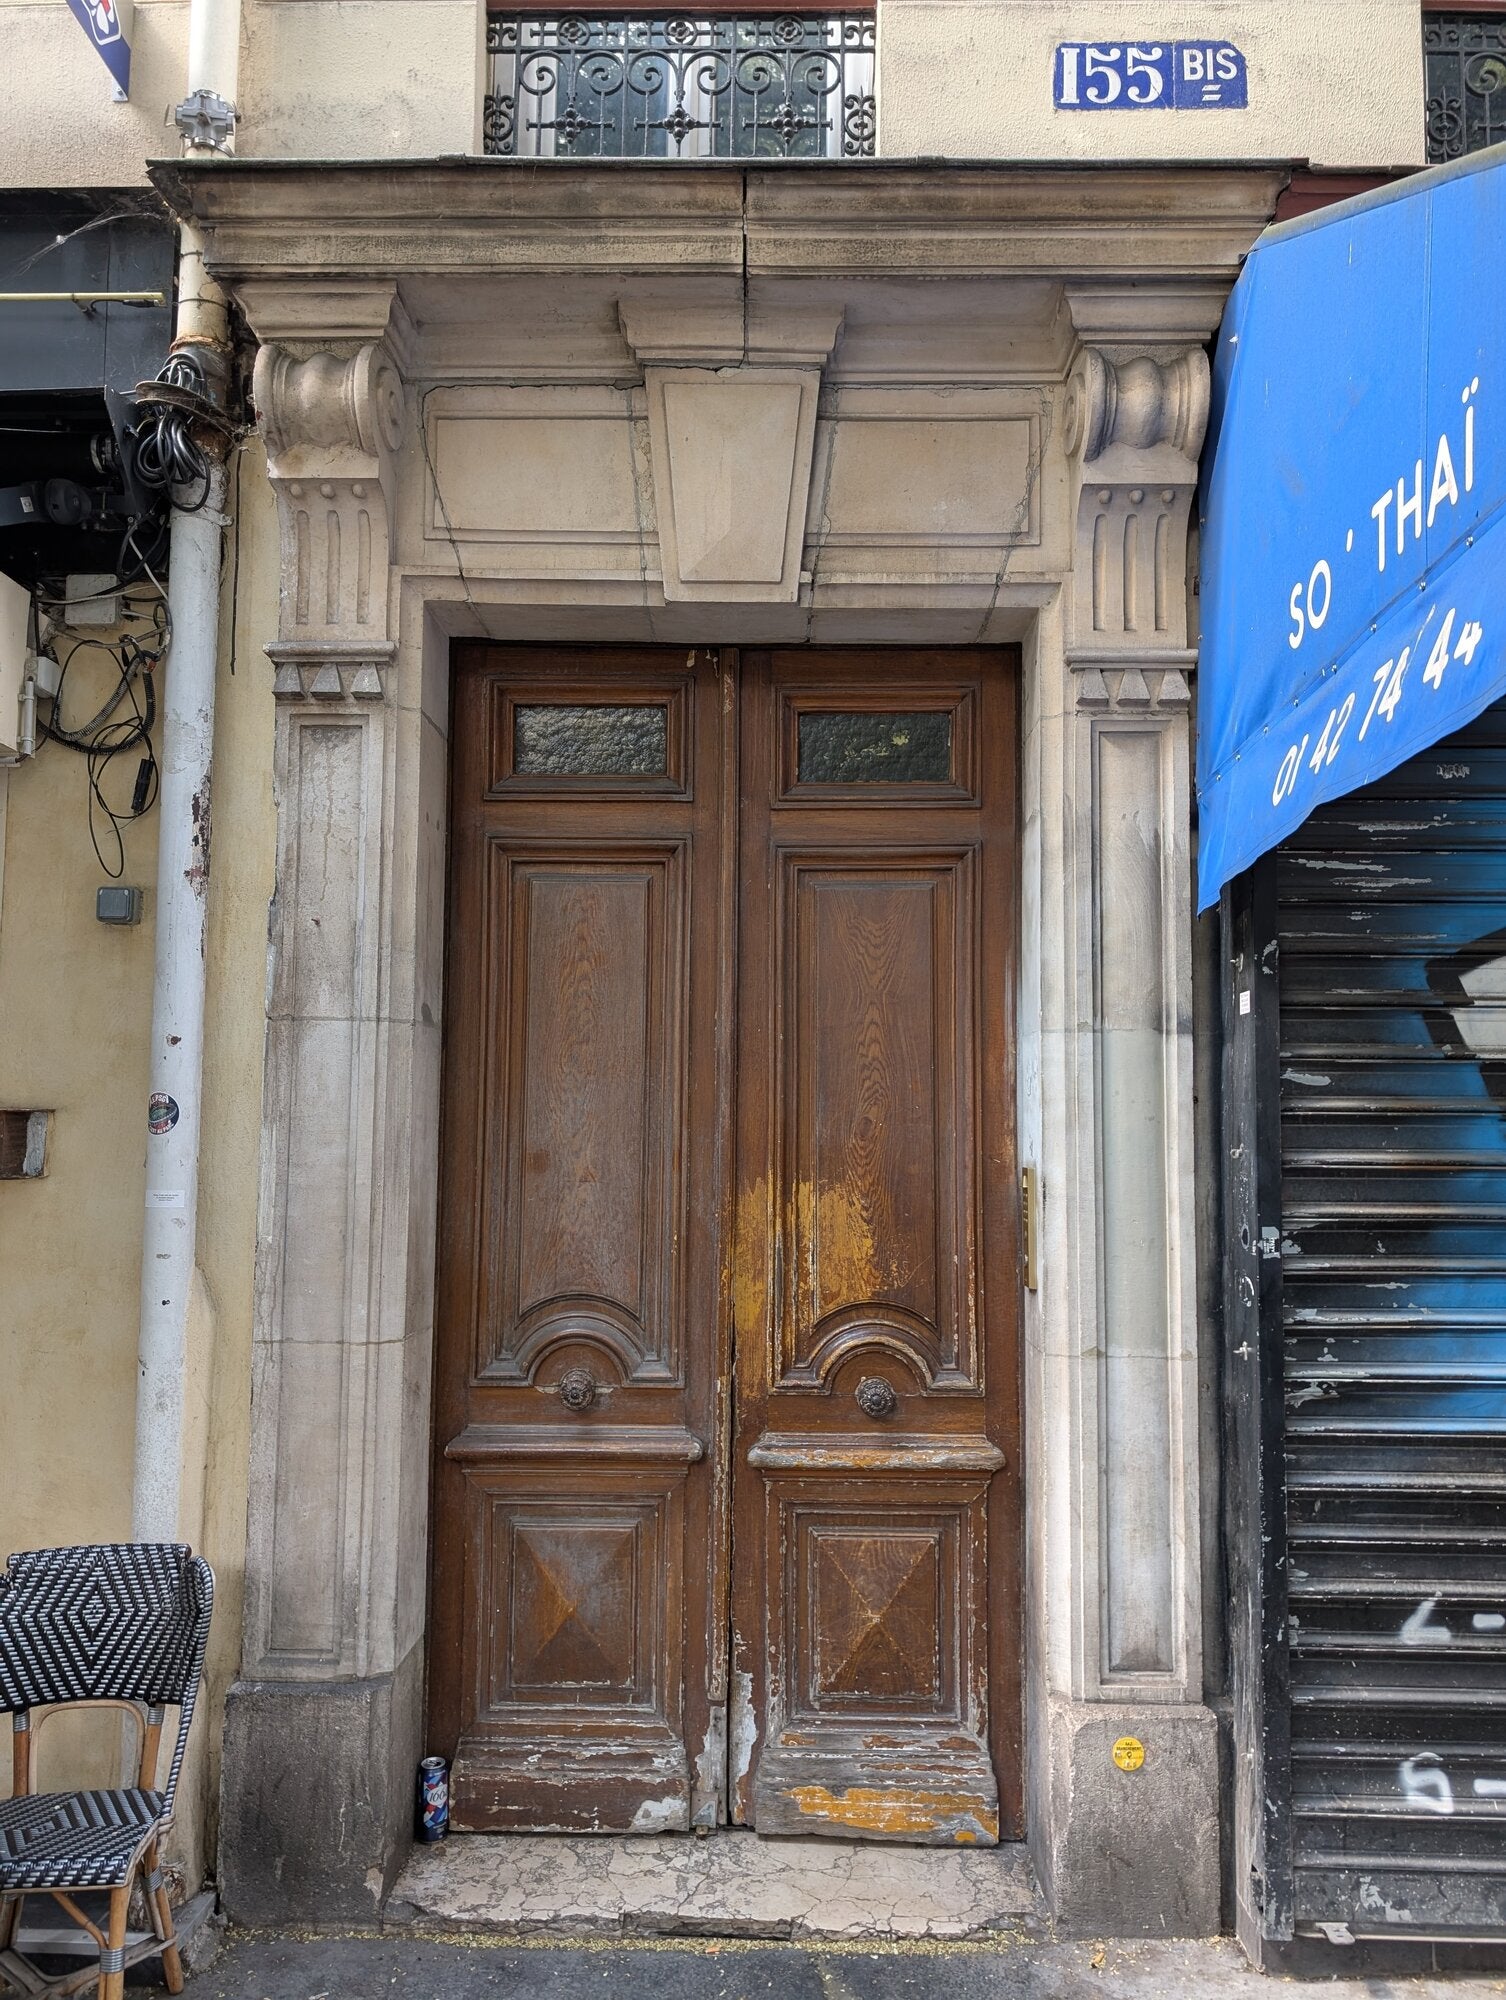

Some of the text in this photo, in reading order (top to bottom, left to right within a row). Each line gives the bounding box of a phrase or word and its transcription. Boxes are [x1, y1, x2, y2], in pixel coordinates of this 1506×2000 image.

[1060, 47, 1238, 104] 155 BIS
[1272, 607, 1484, 807] 01 42 74 44
